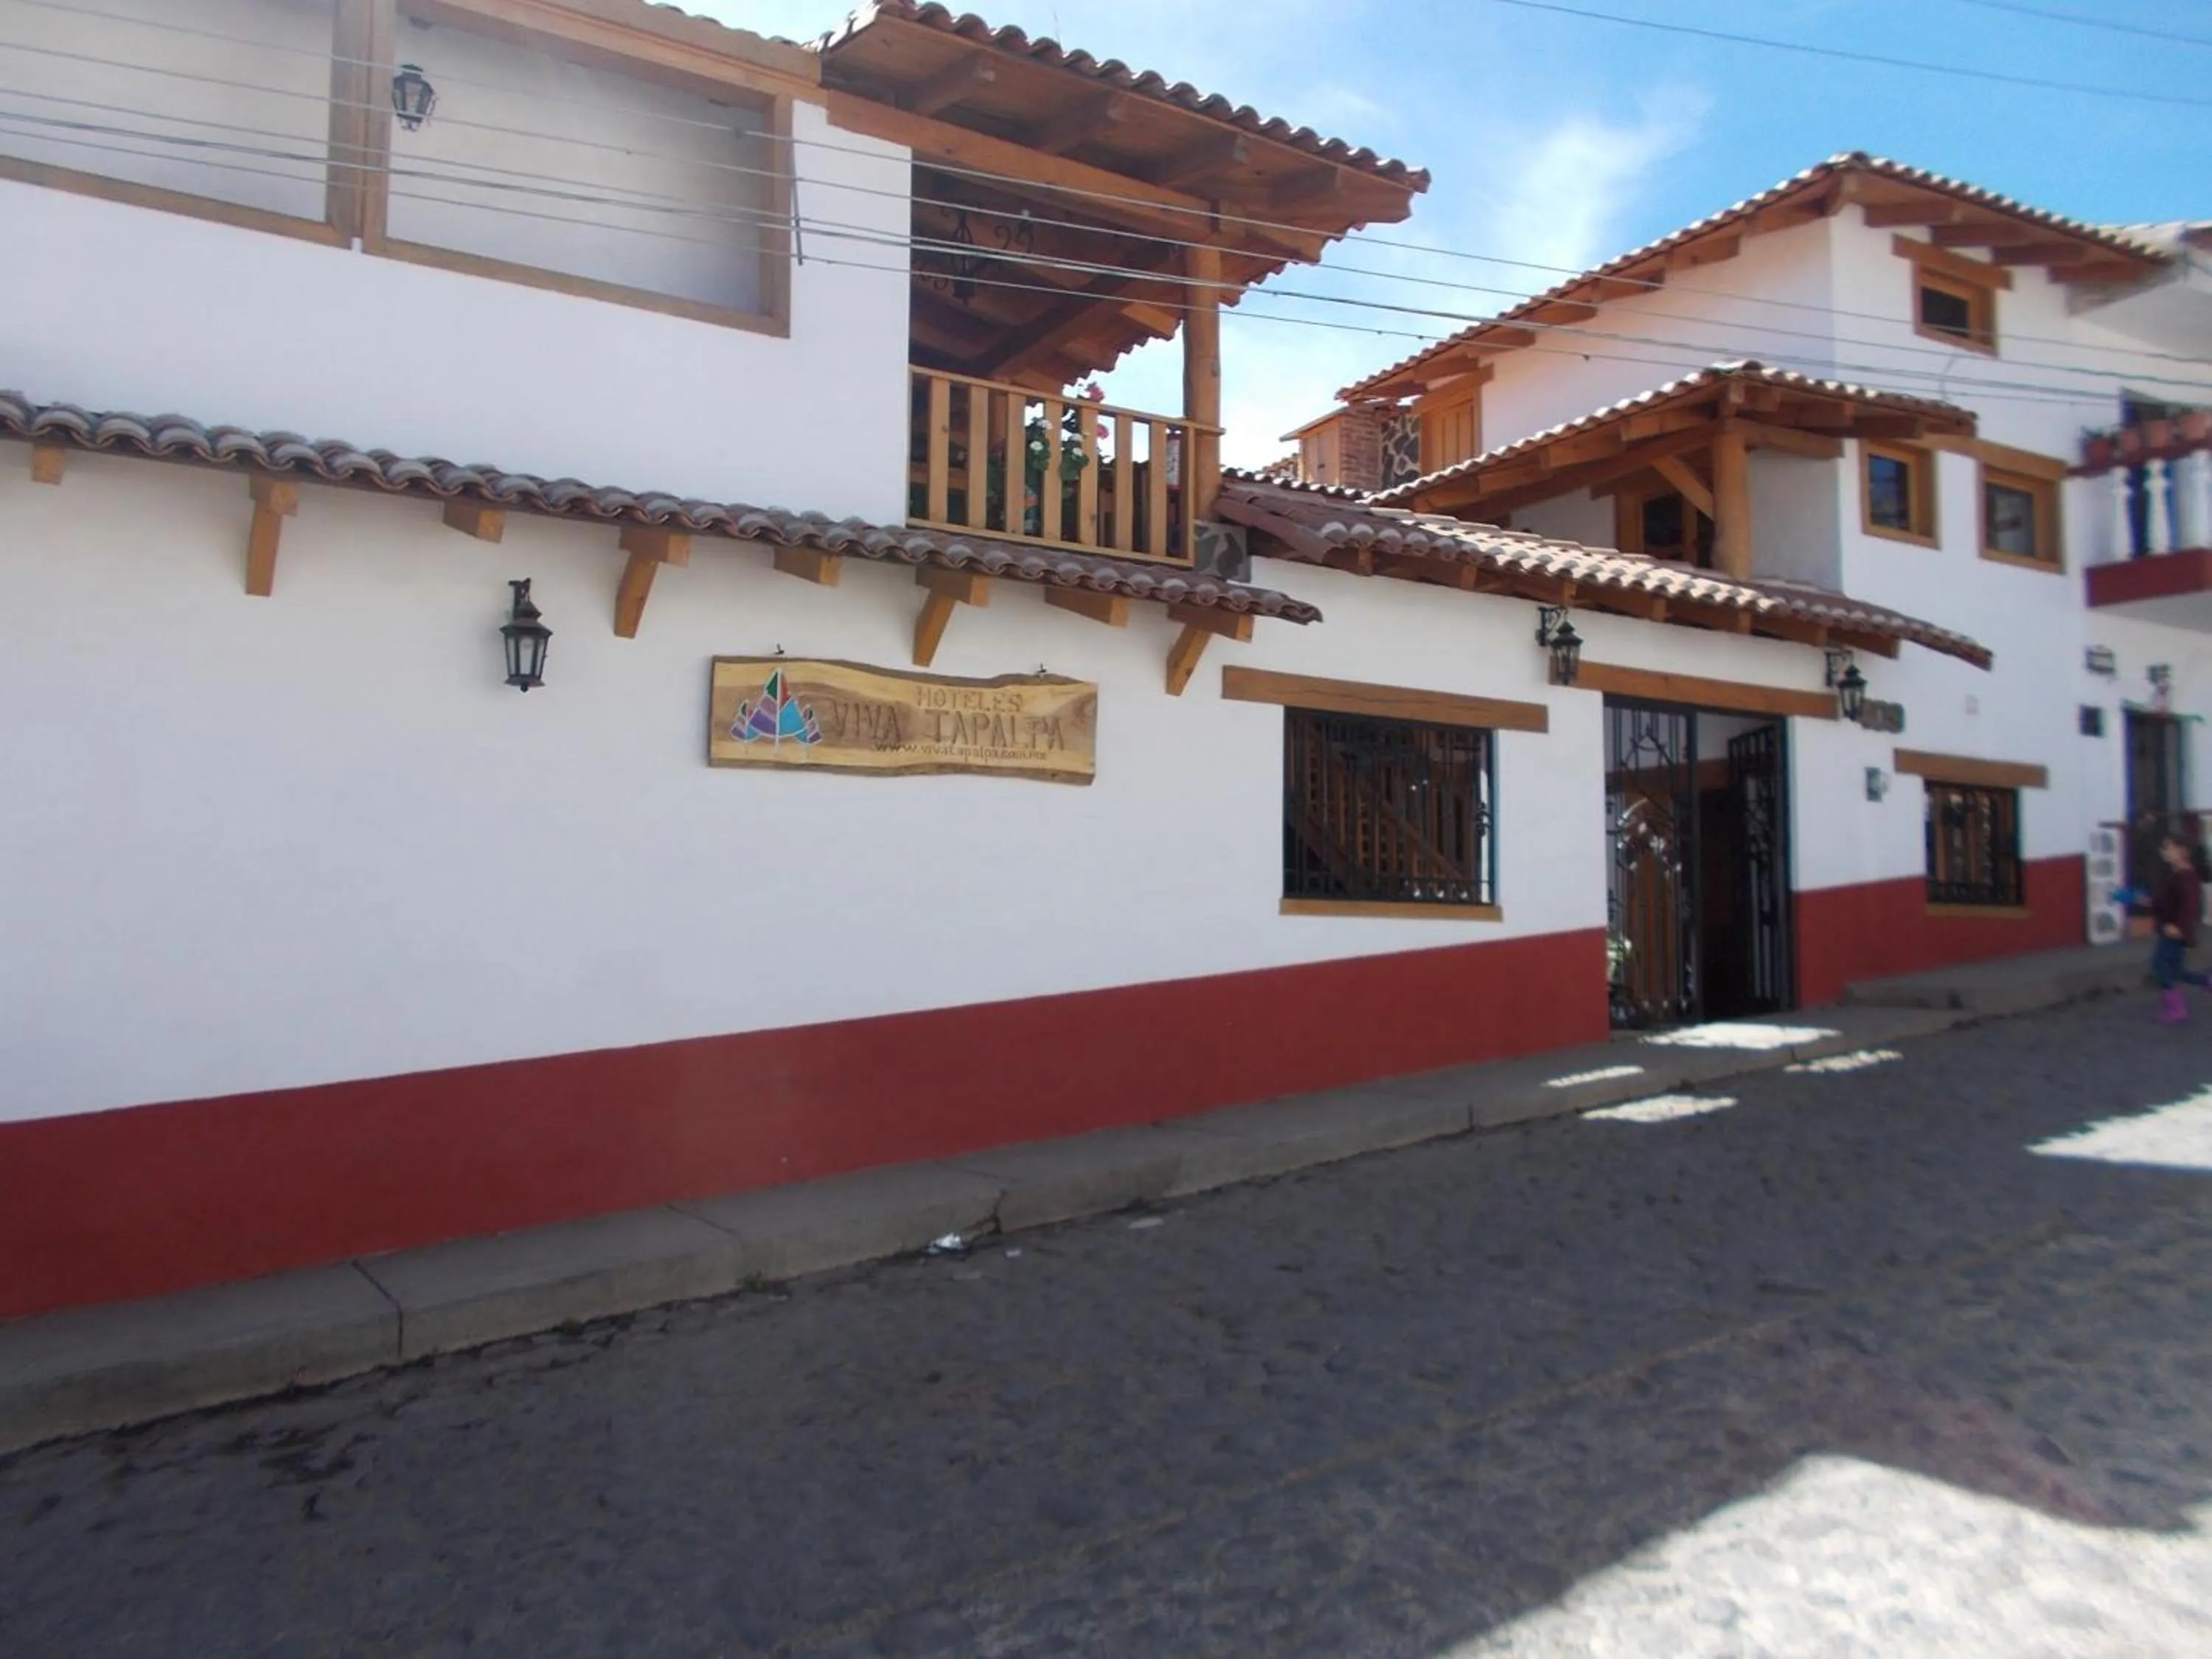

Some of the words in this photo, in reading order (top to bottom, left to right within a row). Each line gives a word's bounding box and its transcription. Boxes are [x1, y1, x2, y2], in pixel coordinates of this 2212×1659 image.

[915, 685, 1024, 713] HOTELES
[830, 700, 901, 742] VIVA
[925, 709, 1065, 752] TAPALPA
